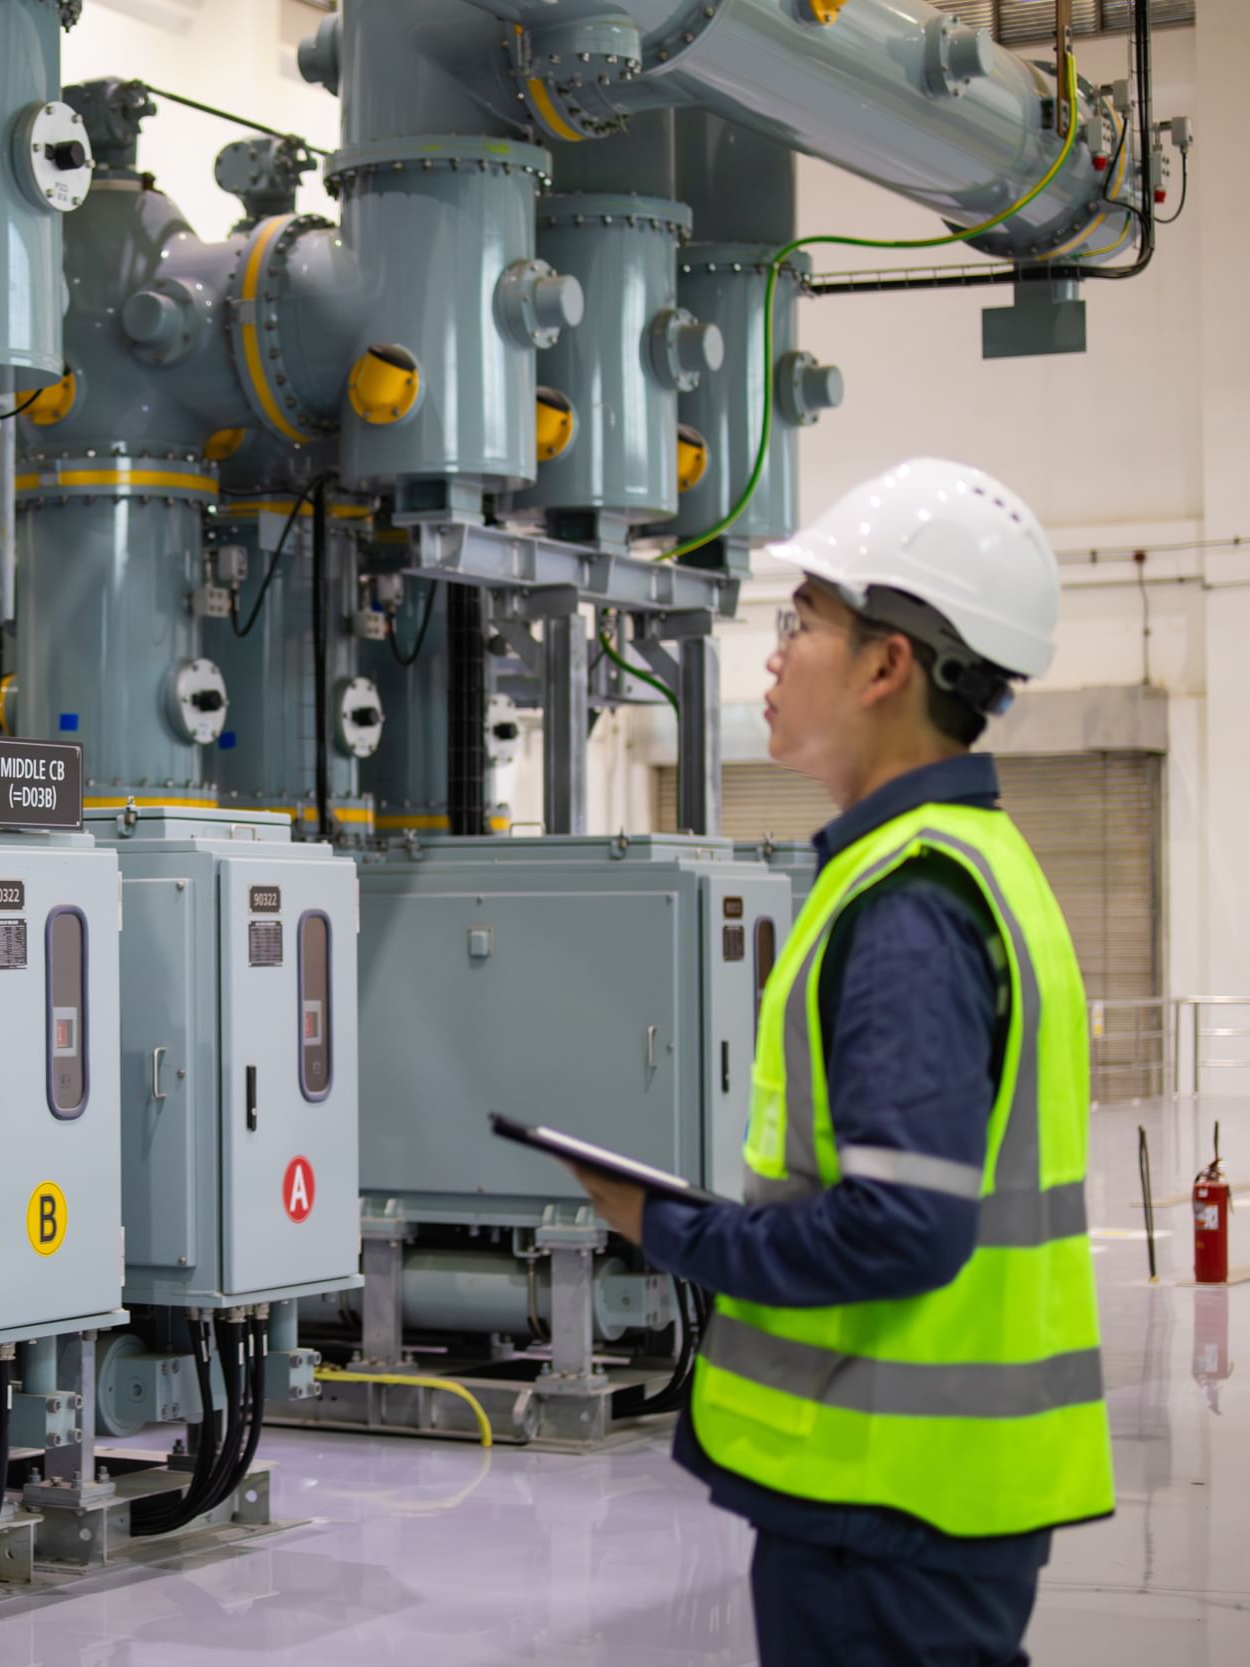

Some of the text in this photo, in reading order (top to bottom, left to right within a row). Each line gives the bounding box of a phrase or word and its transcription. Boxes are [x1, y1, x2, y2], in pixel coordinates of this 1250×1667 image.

[0, 757, 65, 781] MIDDLE CB
[9, 783, 57, 810] (=D03B)
[253, 893, 278, 906] 90322
[290, 1164, 309, 1212] A
[40, 1195, 57, 1243] B
